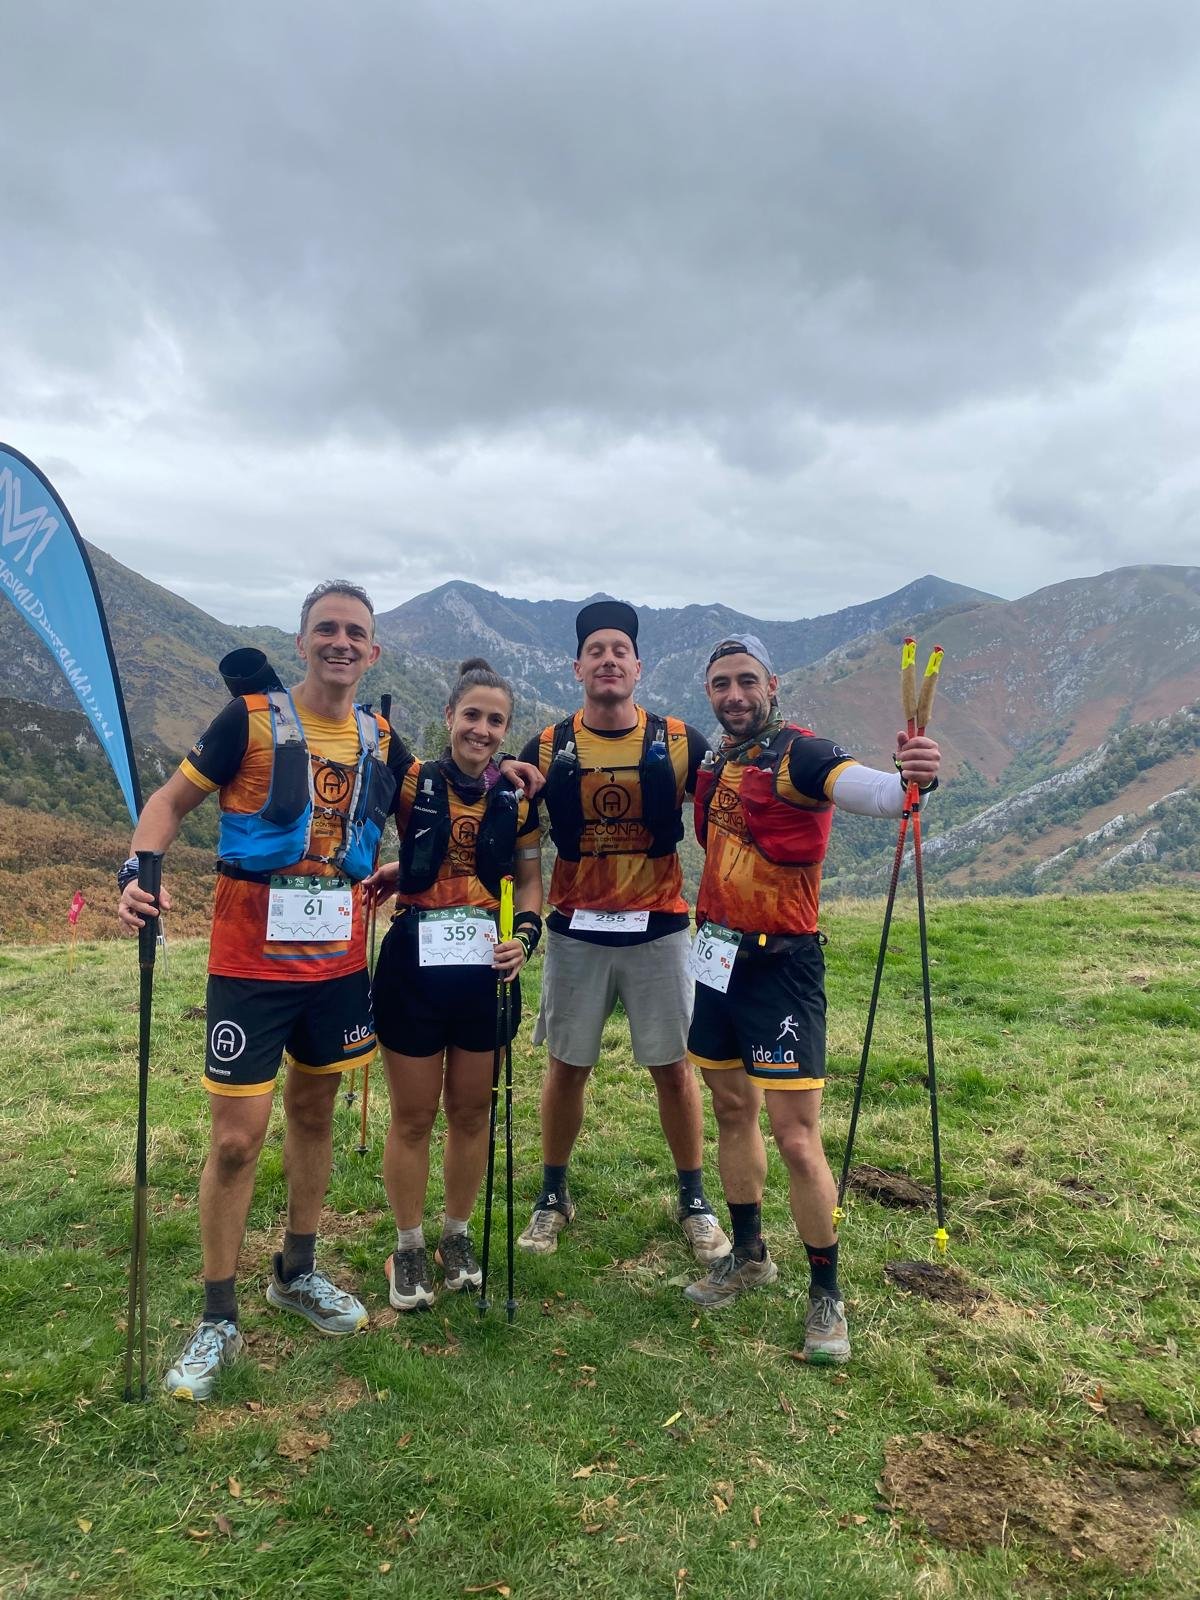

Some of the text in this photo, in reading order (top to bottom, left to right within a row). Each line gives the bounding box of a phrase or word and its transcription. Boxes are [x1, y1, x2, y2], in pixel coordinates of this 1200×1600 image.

[304, 899, 322, 915] 61
[595, 914, 626, 923] 255
[443, 925, 477, 941] 359
[697, 939, 714, 960] 176
[752, 1045, 795, 1063] ideda
